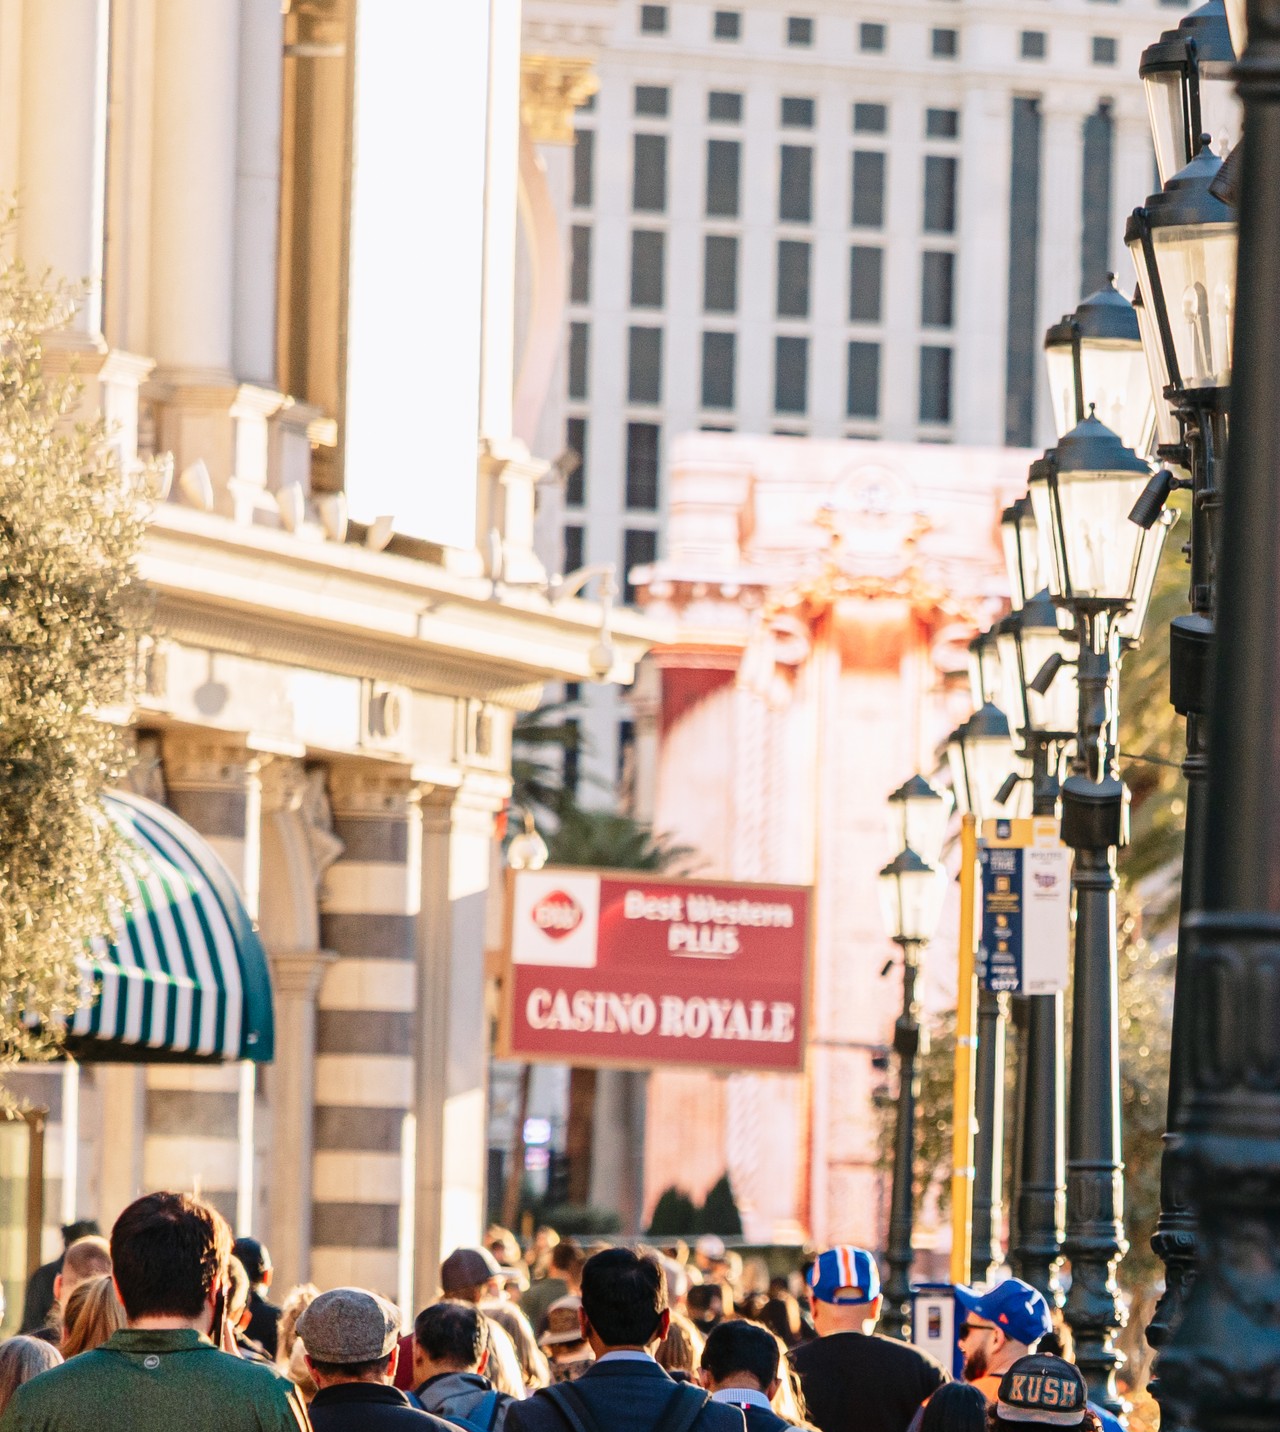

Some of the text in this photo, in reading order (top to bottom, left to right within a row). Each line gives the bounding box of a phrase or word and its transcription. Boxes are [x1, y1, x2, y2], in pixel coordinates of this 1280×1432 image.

[624, 889, 794, 928] Best Western
[668, 922, 741, 954] PLUS
[526, 987, 796, 1043] CASINO ROYALE
[1009, 1373, 1078, 1407] KUSH
